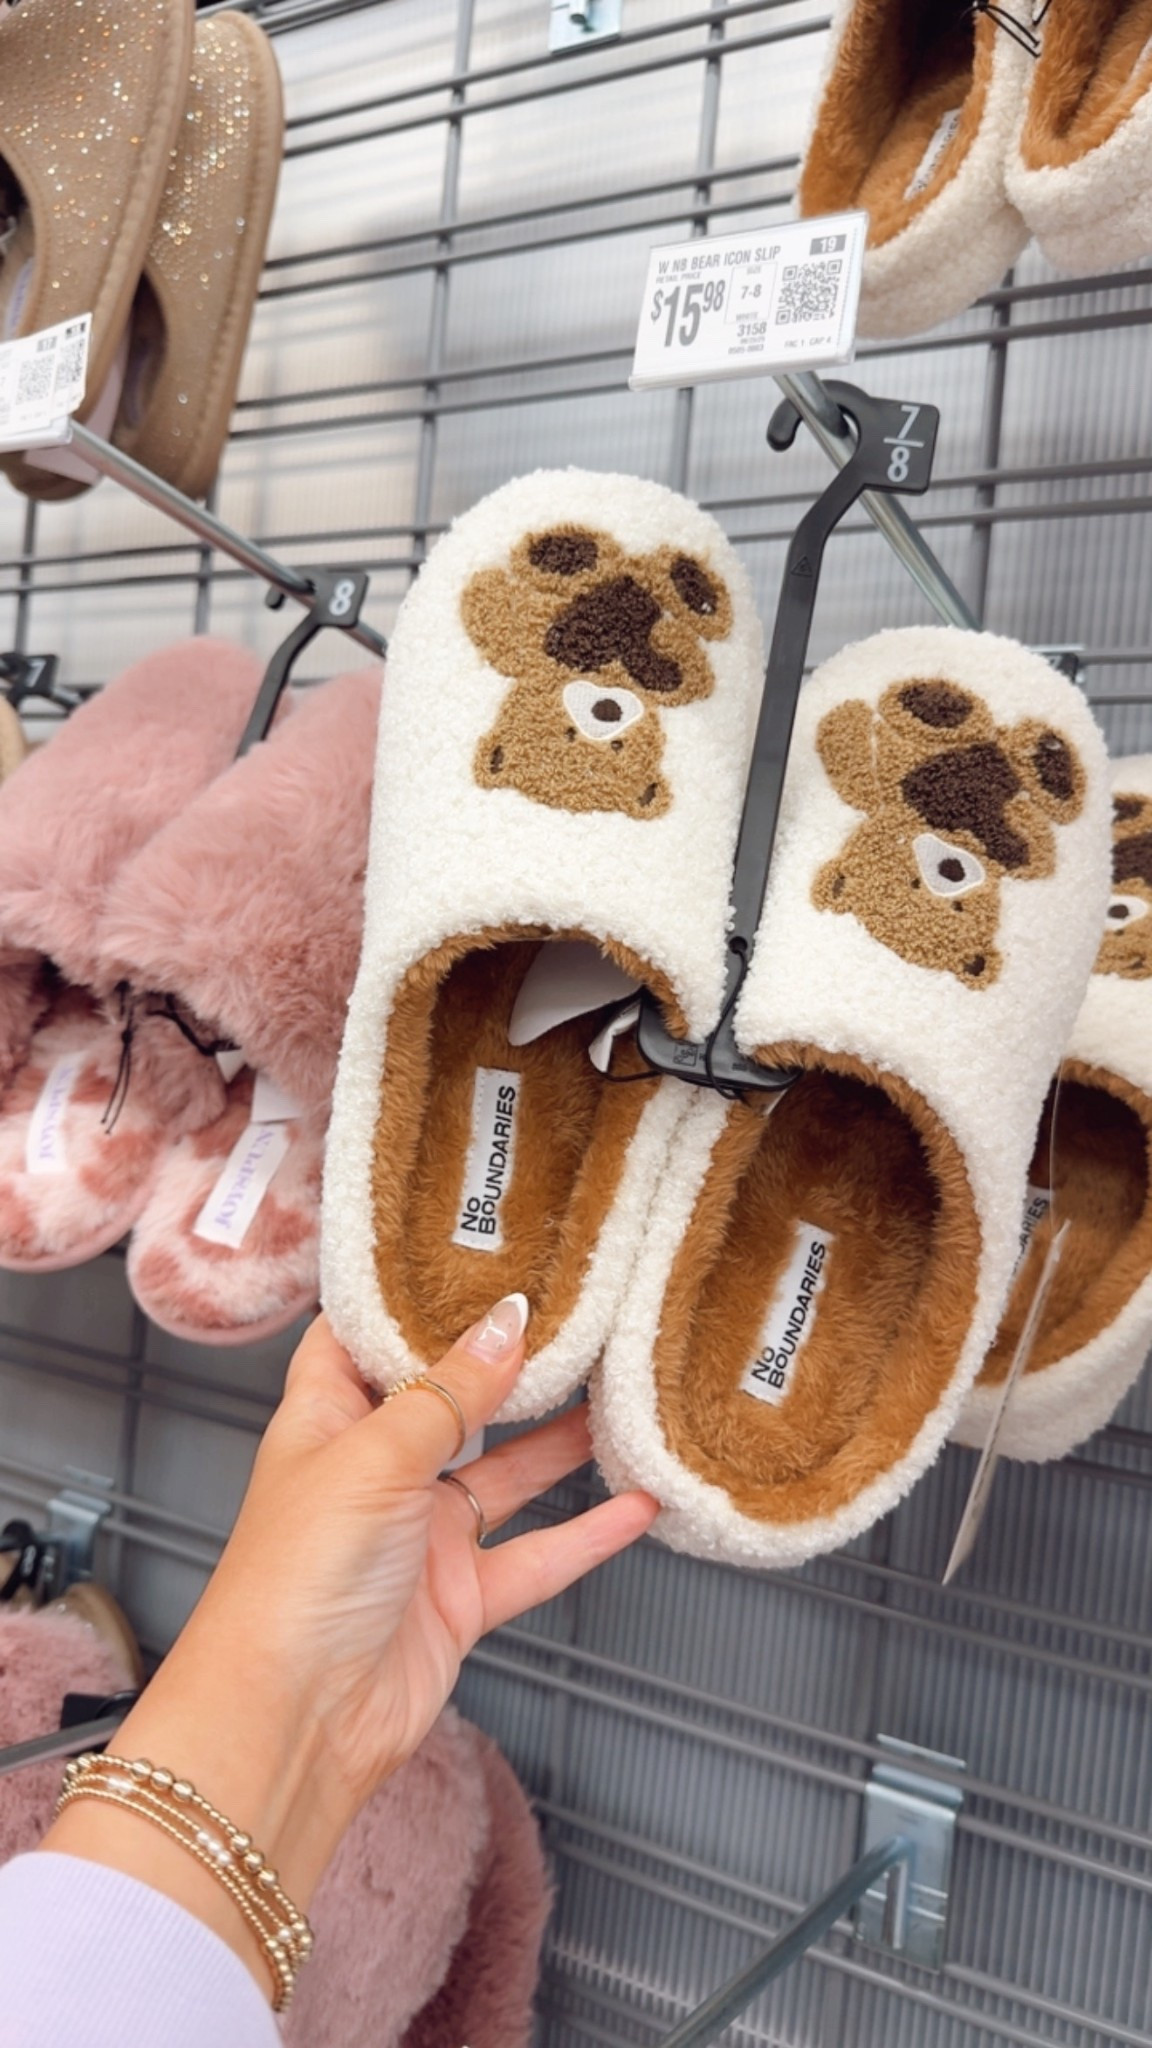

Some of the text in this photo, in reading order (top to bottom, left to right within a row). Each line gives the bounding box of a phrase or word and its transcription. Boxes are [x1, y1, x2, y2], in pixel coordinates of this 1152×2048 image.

[820, 236, 837, 252] 19
[658, 245, 781, 274] W NB BEAR ICON SLIP
[681, 271, 702, 280] PRICE
[741, 284, 762, 299] 7-8
[737, 321, 767, 337] 3158
[329, 579, 355, 616] 8
[25, 658, 47, 688] 7
[478, 1085, 516, 1235] BOUNDARIES
[461, 1197, 481, 1232] NO
[768, 1241, 826, 1389] BOUNDARIES
[751, 1347, 775, 1382] NO
